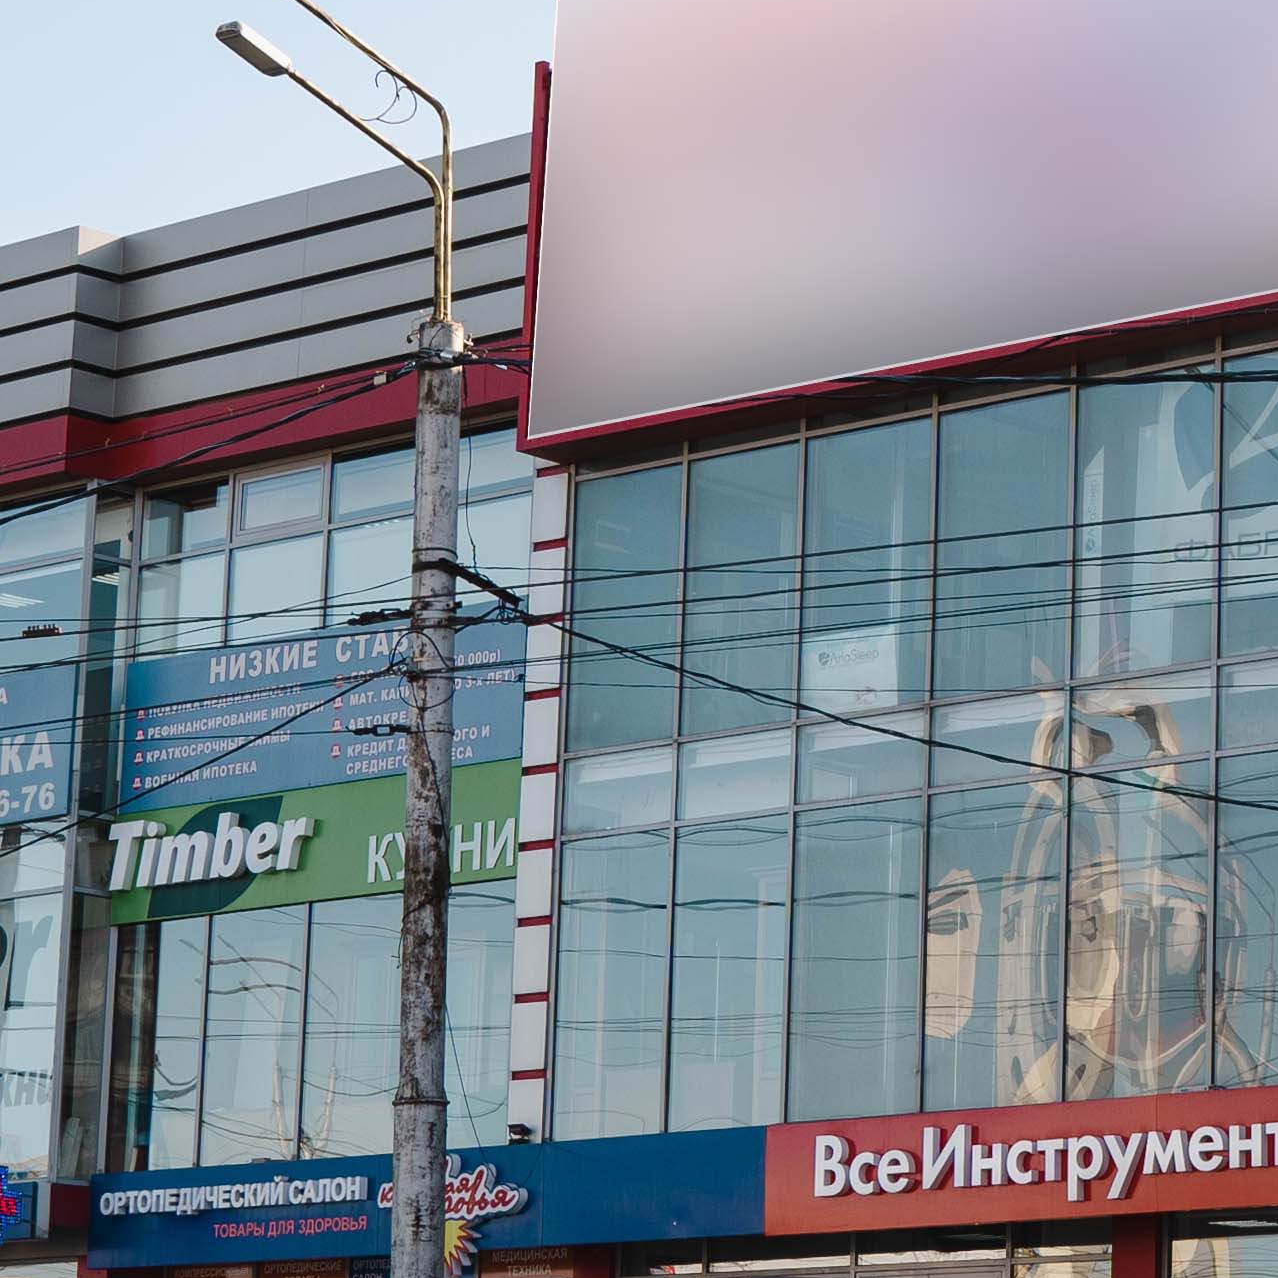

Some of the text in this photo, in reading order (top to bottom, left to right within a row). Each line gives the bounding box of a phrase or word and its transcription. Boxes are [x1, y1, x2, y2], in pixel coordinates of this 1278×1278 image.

[209, 640, 319, 684] НИЗКИЕ
[148, 710, 269, 739] РЕФИНАНСИРОВАНИЕ
[146, 736, 246, 764] КРАТКОСРОЧНЫЕ
[347, 739, 394, 758] КРЕДИТ
[203, 760, 257, 781] ИПОТЕКА
[108, 811, 315, 891] Timber
[100, 1175, 287, 1216] ОРТОПЕДИЧЕСКИЙ
[288, 1176, 368, 1204] САЛОН
[213, 1215, 368, 1239] ТОВАРЫ ДЛЯ ЗДОРОВЬЯ
[264, 1259, 344, 1274] ОРТОПЕДИЧЕСКИЕ
[492, 1247, 568, 1262] МЕДИЦИНСКАЯ
[507, 1263, 552, 1277] ТЕХНИКА
